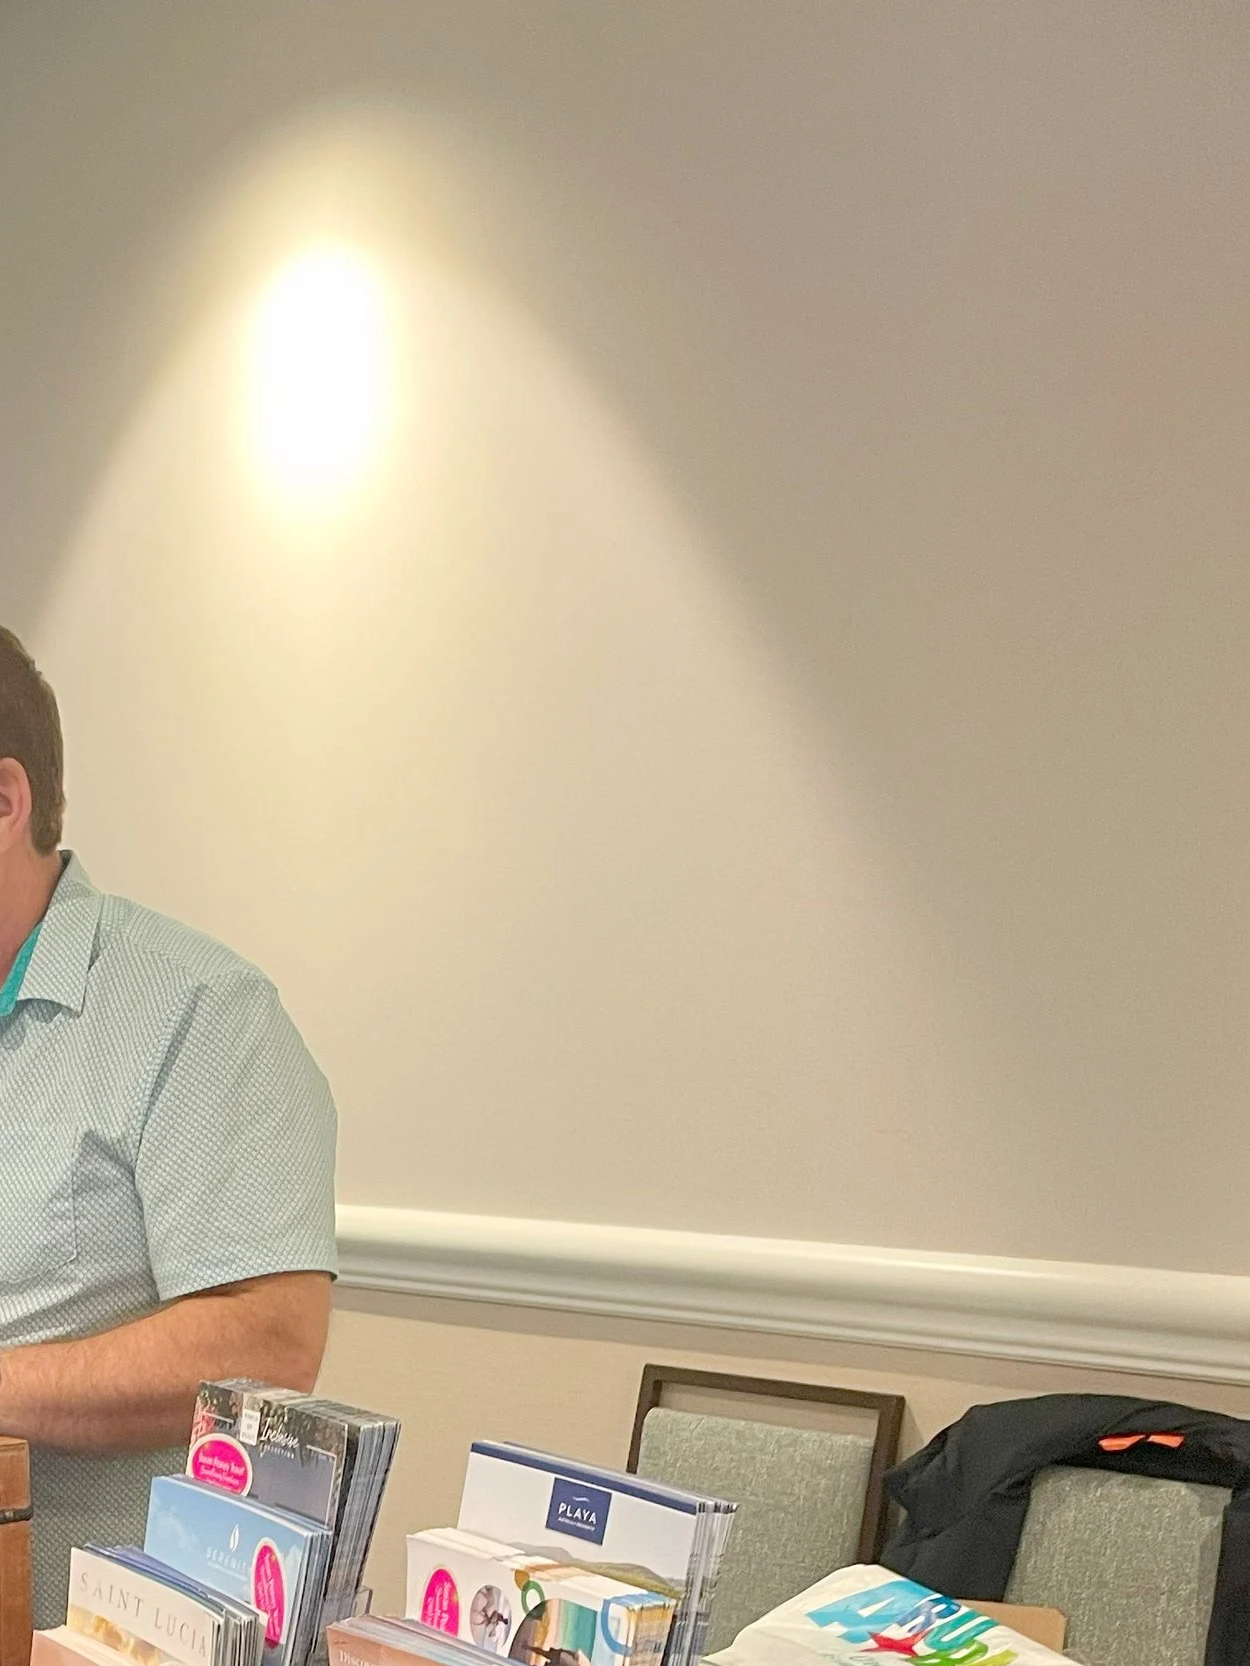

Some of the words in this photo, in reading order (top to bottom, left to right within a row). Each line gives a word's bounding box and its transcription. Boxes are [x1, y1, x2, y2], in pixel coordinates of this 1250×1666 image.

[558, 1502, 597, 1525] PLAYA
[206, 1546, 248, 1570] SERENIT
[79, 1572, 144, 1618] SAINT
[154, 1607, 207, 1658] LUCIA
